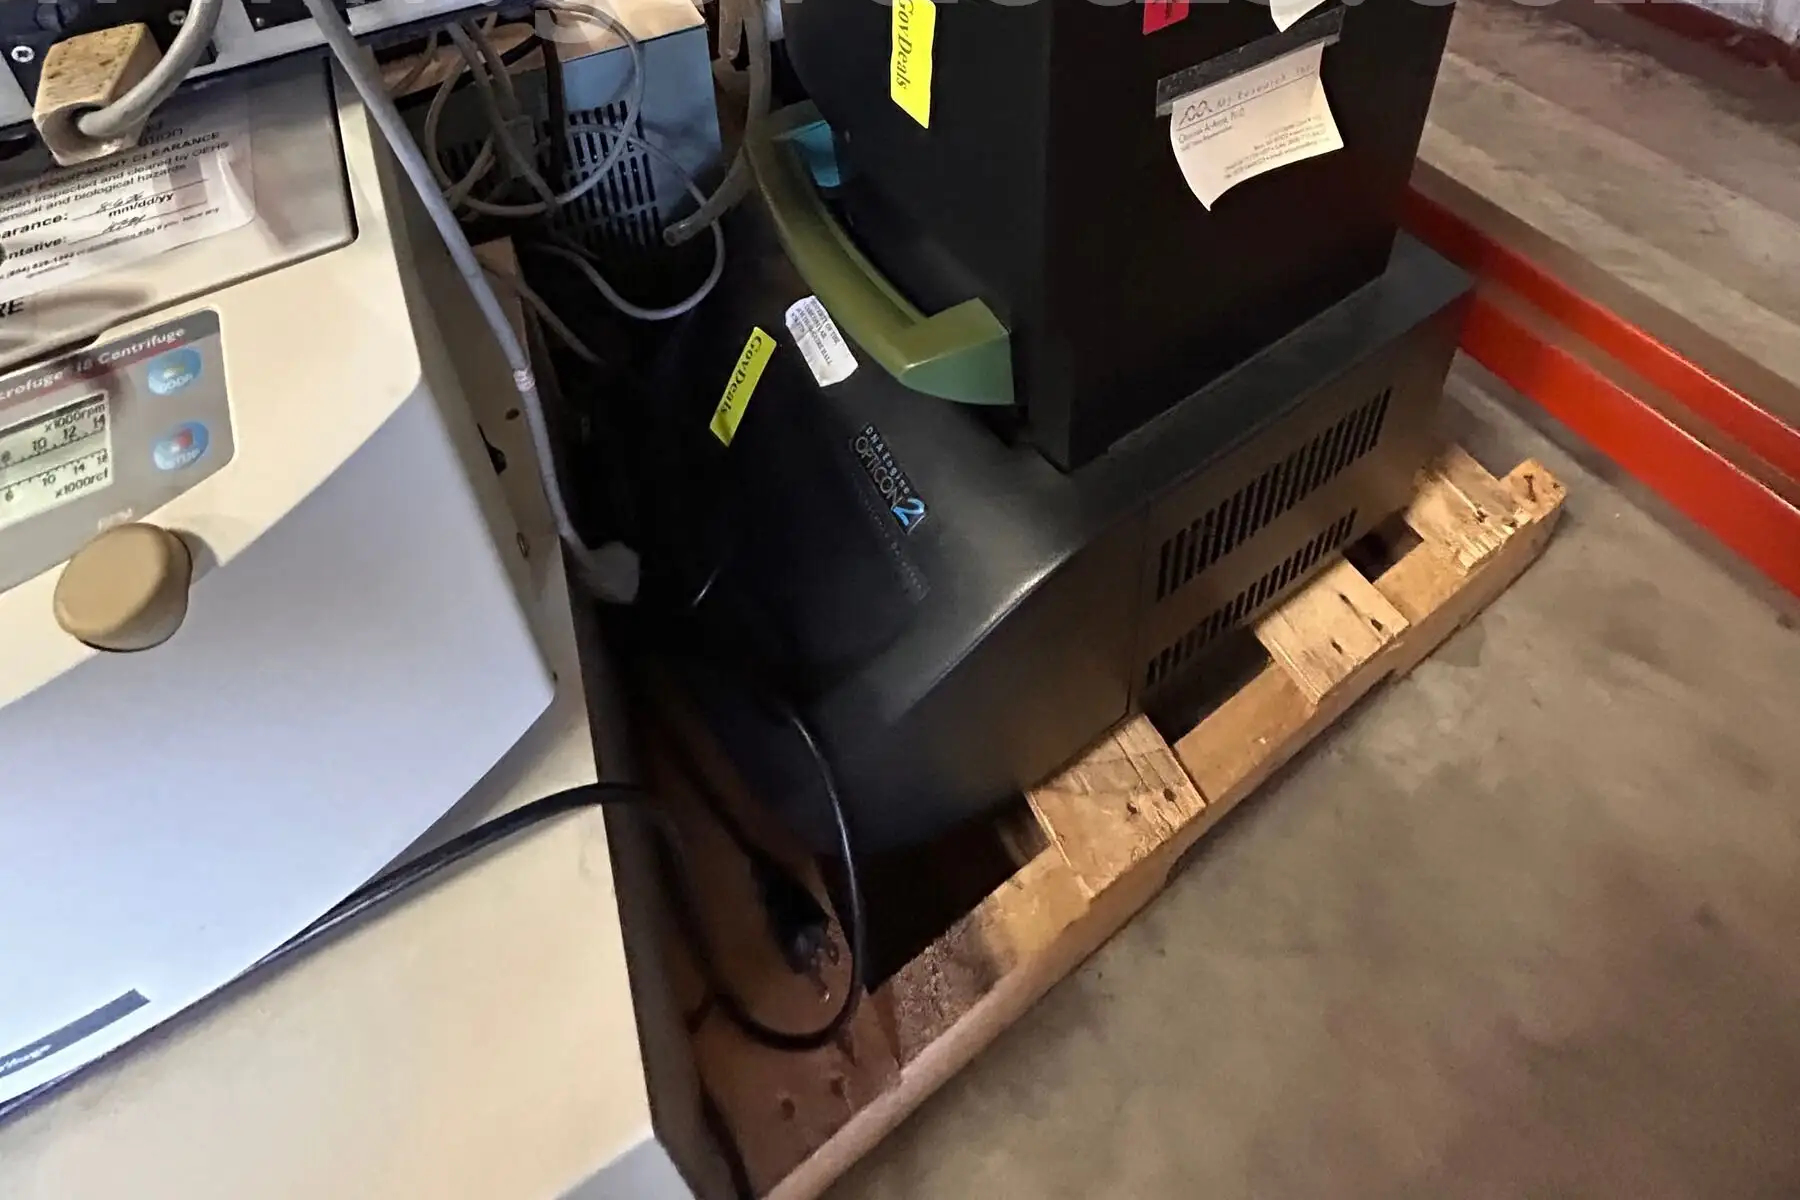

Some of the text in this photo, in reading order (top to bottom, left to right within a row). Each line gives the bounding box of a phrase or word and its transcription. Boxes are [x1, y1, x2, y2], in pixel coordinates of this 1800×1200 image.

[133, 132, 219, 163] CLEARANCE
[101, 170, 124, 184] and
[46, 196, 70, 210] and
[74, 177, 134, 201] biological
[108, 192, 174, 218] mm/dd/yy
[1, 212, 68, 239] arance:
[98, 328, 186, 363] Centrifuge
[720, 335, 762, 414] GovDeals
[44, 404, 105, 432] x1000rpm
[32, 437, 47, 451] 10
[63, 426, 77, 440] 12
[866, 426, 883, 451] DNA
[55, 470, 108, 498] x1000rcf
[855, 436, 903, 511] OPTICON
[892, 498, 925, 526] 2
